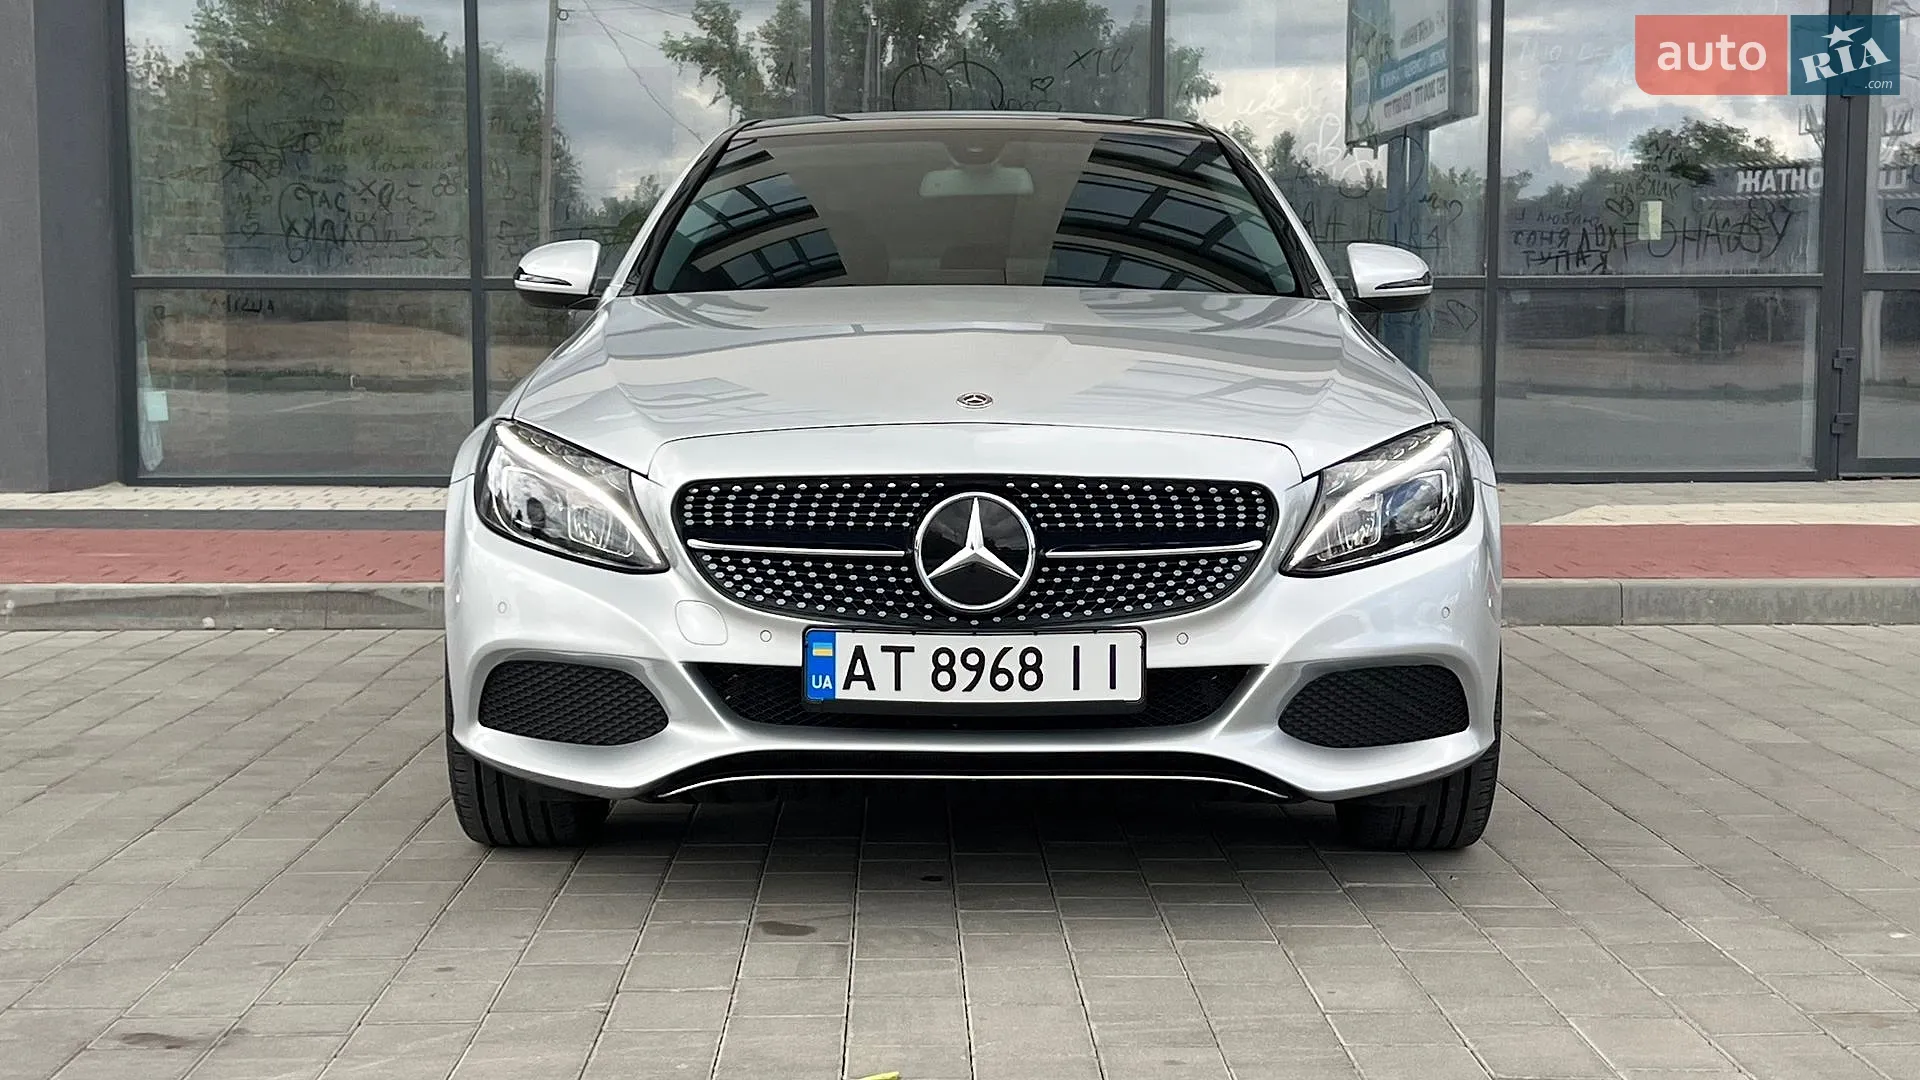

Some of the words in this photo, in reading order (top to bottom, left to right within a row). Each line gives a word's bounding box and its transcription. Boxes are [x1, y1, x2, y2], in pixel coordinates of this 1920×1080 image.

[811, 674, 833, 690] UA
[842, 644, 916, 692] AT
[931, 645, 1045, 692] 8968
